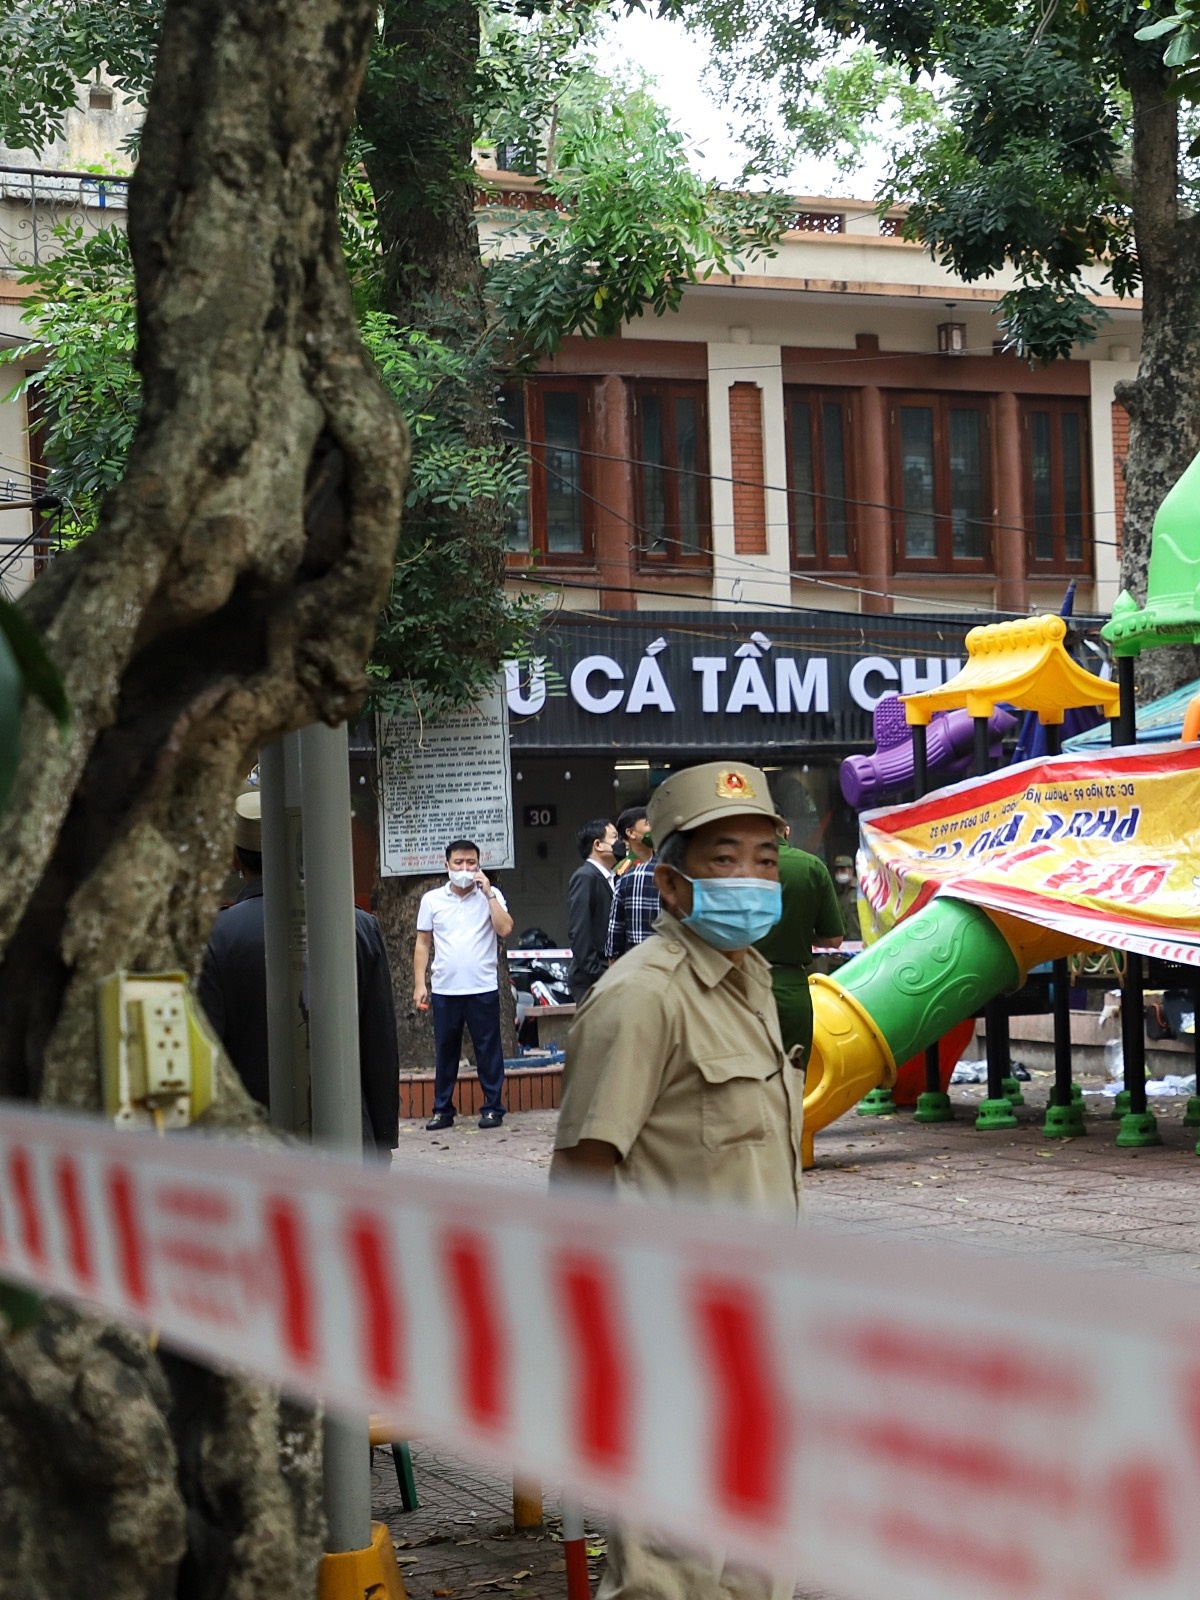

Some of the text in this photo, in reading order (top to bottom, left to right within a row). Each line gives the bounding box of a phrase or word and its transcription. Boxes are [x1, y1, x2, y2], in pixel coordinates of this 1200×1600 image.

[570, 637, 676, 714] CÁ
[692, 631, 829, 713] TẦM
[1074, 789, 1085, 800] 65
[530, 810, 551, 825] 30
